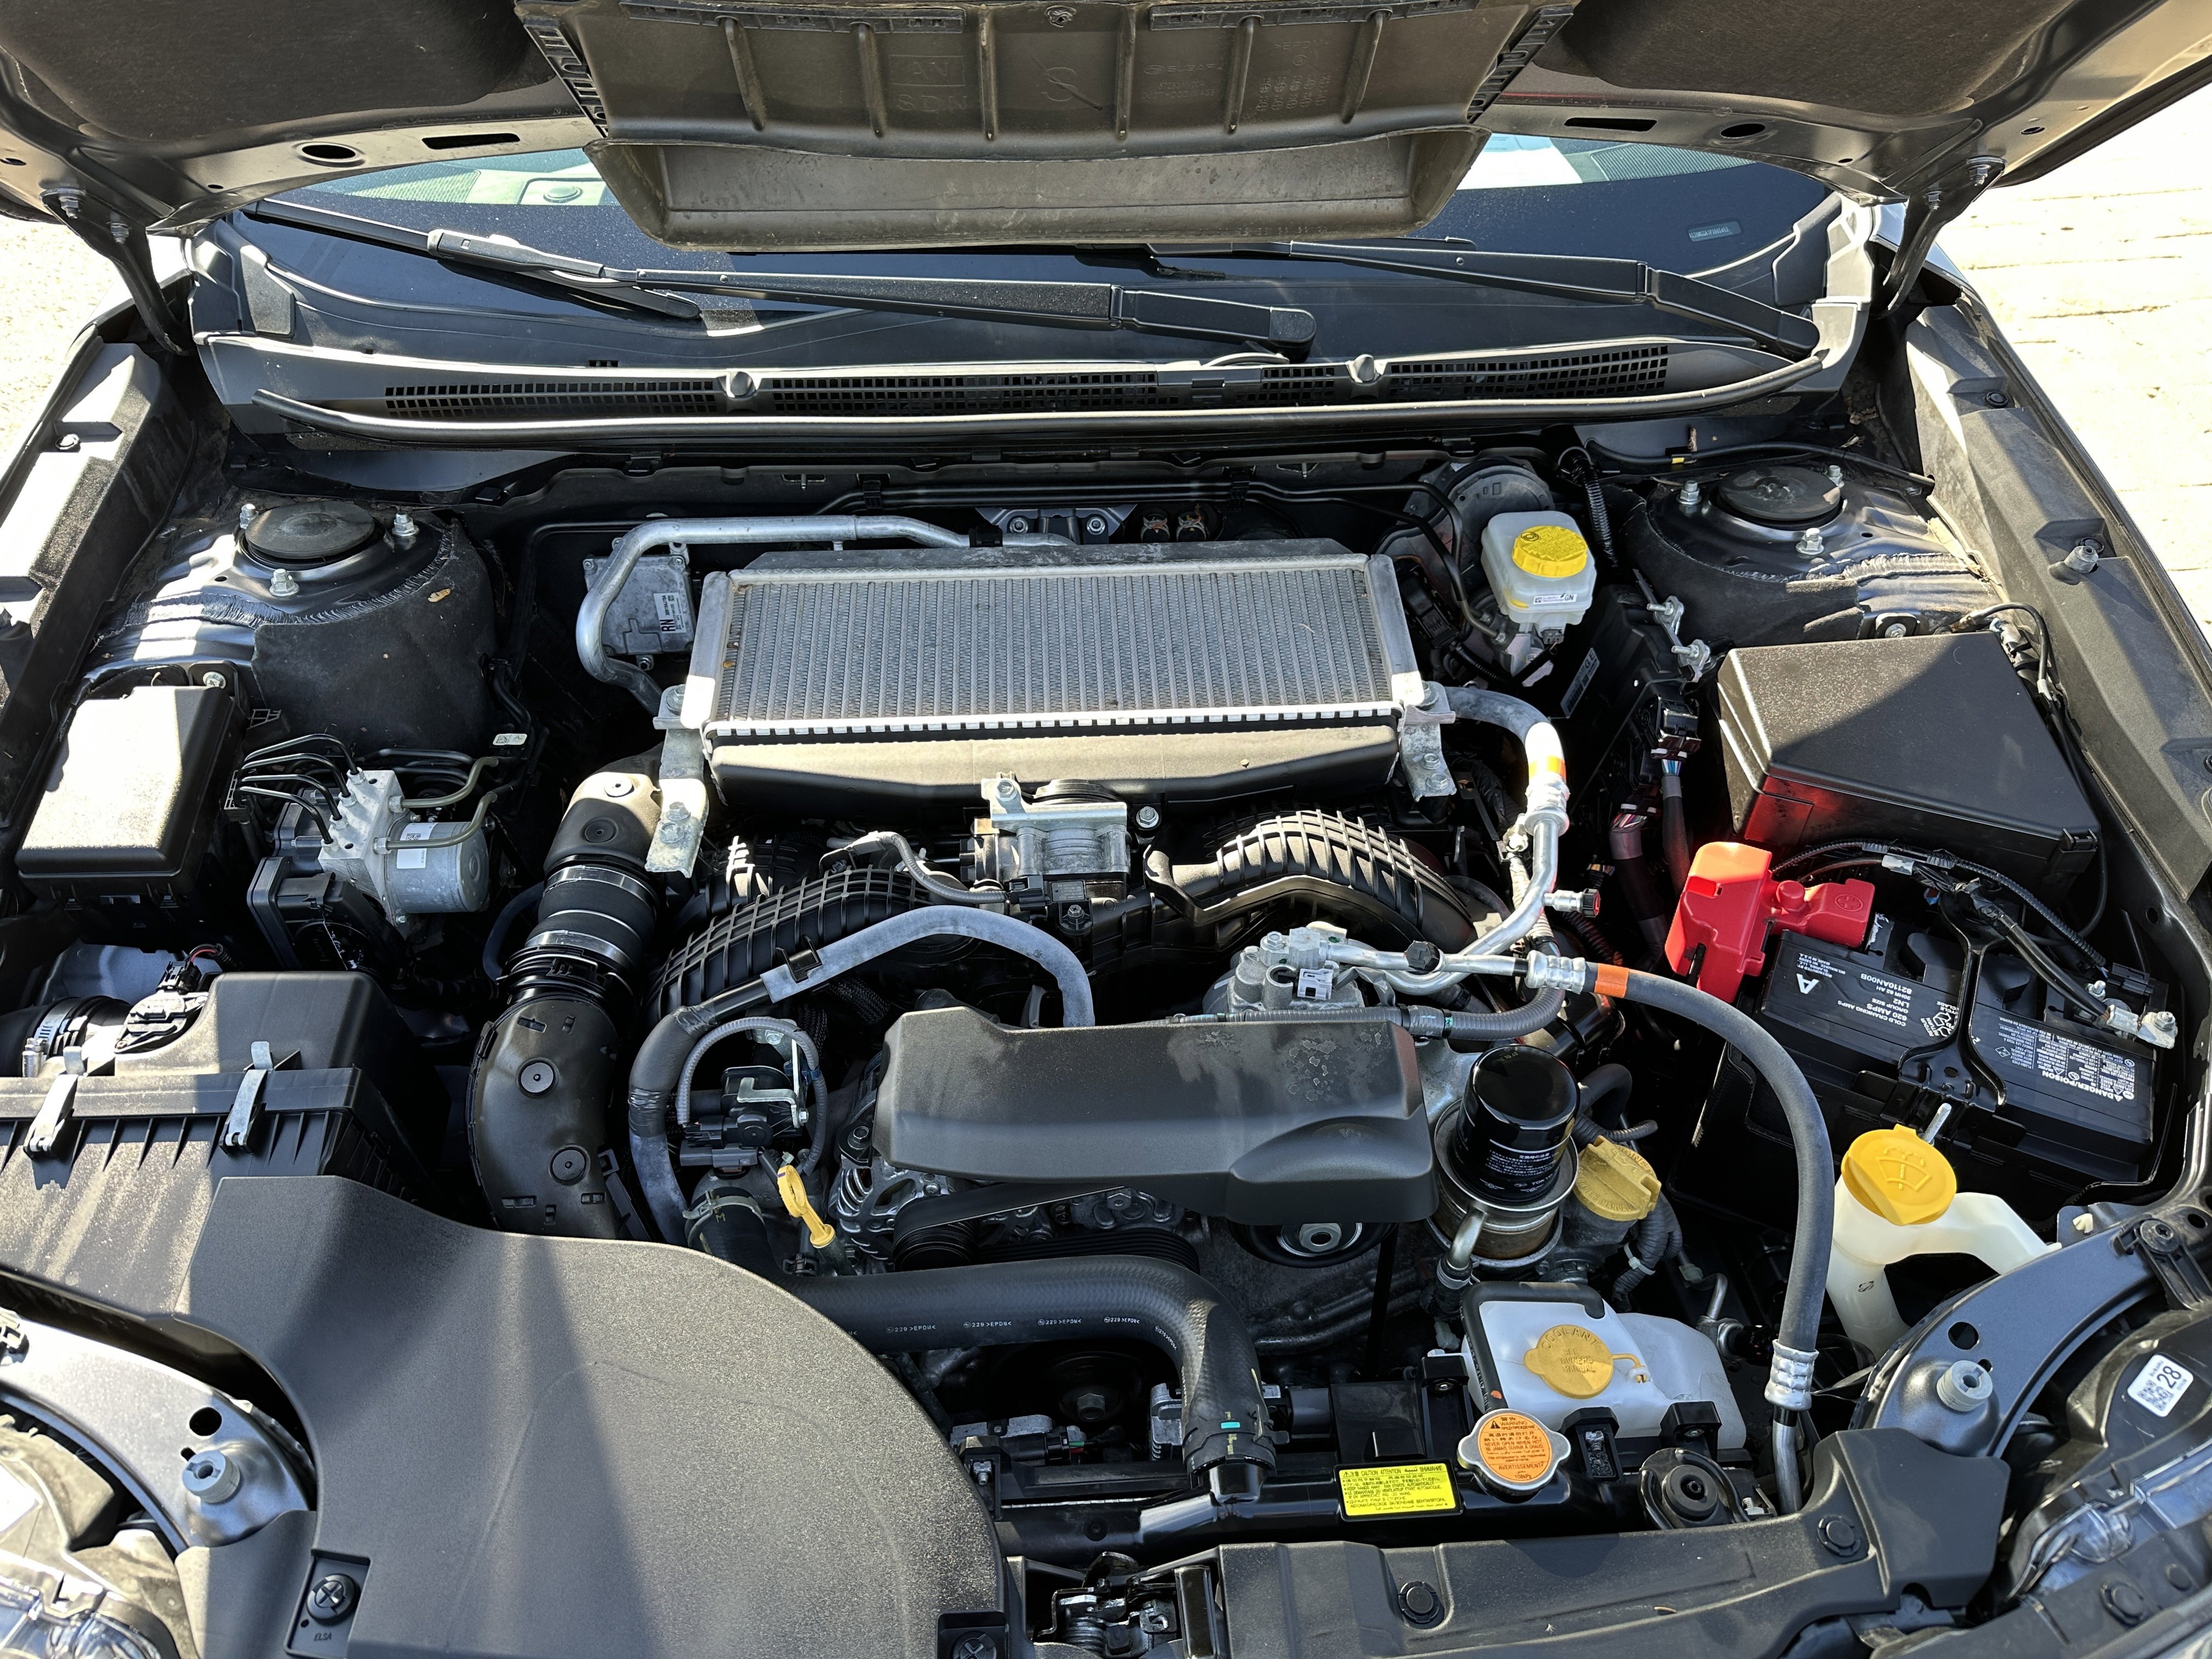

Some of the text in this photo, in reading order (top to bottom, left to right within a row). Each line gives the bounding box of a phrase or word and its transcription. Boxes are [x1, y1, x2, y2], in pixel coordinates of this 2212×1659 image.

[659, 619, 675, 631] RN
[1797, 974, 1819, 994] A
[1861, 974, 1912, 994] 82110AN00B
[1893, 998, 1909, 1008] LN2
[1895, 992, 1911, 1000] 20HR
[1838, 1001, 1906, 1026] COLD CRANKING AMPS
[1867, 1003, 1907, 1020] 620 AMPS
[1886, 1004, 1908, 1013] GROUP
[2042, 1070, 2113, 1098] DANGER/POISON
[1601, 1199, 1633, 1212] MANUAL
[1542, 1328, 1599, 1350] COOLANT
[1564, 1365, 1596, 1373] MANUAL
[2157, 1365, 2181, 1389] 28
